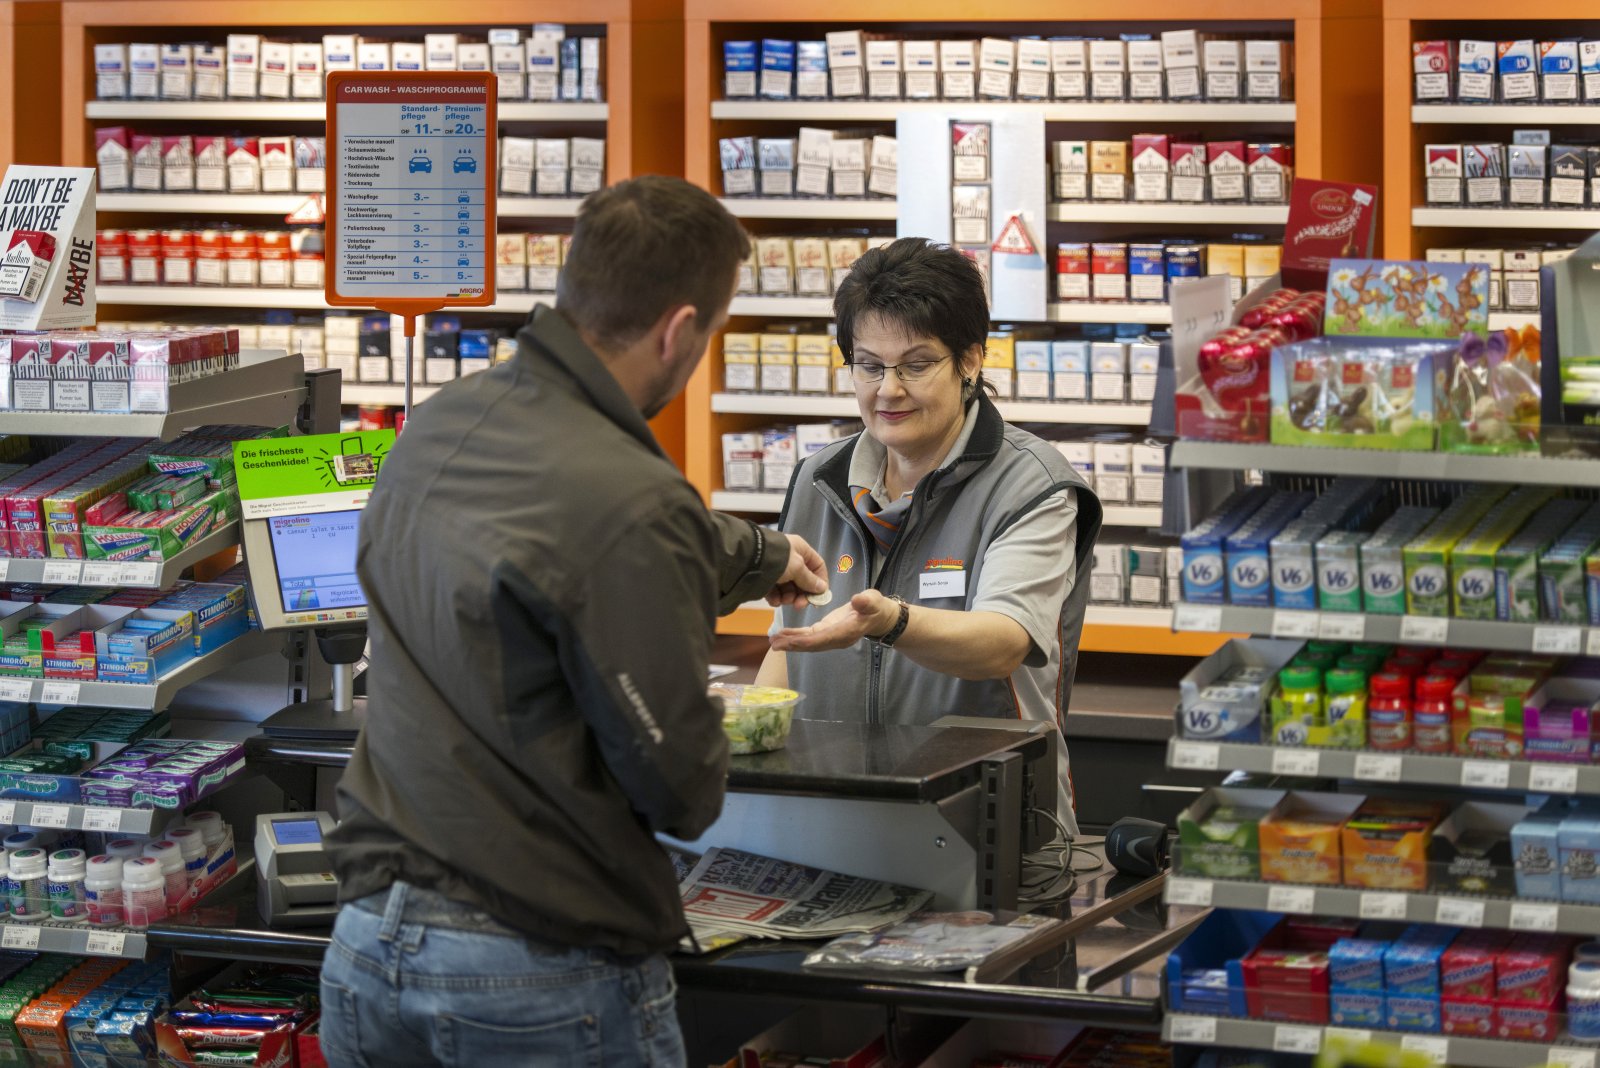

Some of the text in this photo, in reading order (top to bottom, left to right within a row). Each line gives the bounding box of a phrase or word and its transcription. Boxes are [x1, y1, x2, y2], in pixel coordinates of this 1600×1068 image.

[51, 178, 77, 204] BE
[7, 205, 65, 232] MAYBE
[241, 447, 304, 458] Die frischeste
[158, 461, 205, 471] HOLLYWOOD
[242, 457, 309, 470] Geschenkidee!
[176, 505, 209, 533] HOLLYWOOD
[94, 532, 144, 544] HOLLYWOOD
[1191, 564, 1212, 580] V6
[1237, 566, 1258, 582] V6
[1281, 568, 1301, 585] V6
[1326, 570, 1347, 587] V6
[1371, 572, 1392, 590] V6
[1414, 575, 1435, 592] V6
[1461, 577, 1482, 595] V6
[199, 599, 234, 620] STIMOROL
[149, 625, 182, 646] STIMOROL
[46, 660, 81, 668] STIMOROL
[99, 662, 134, 672] STIMOROL
[1188, 710, 1211, 728] V6
[1278, 729, 1297, 743] V6
[134, 791, 179, 807] Airwaves
[1443, 964, 1492, 985] mentos
[1499, 967, 1547, 988] mentos
[204, 1032, 248, 1044] Branche
[202, 1054, 246, 1064] Branche
